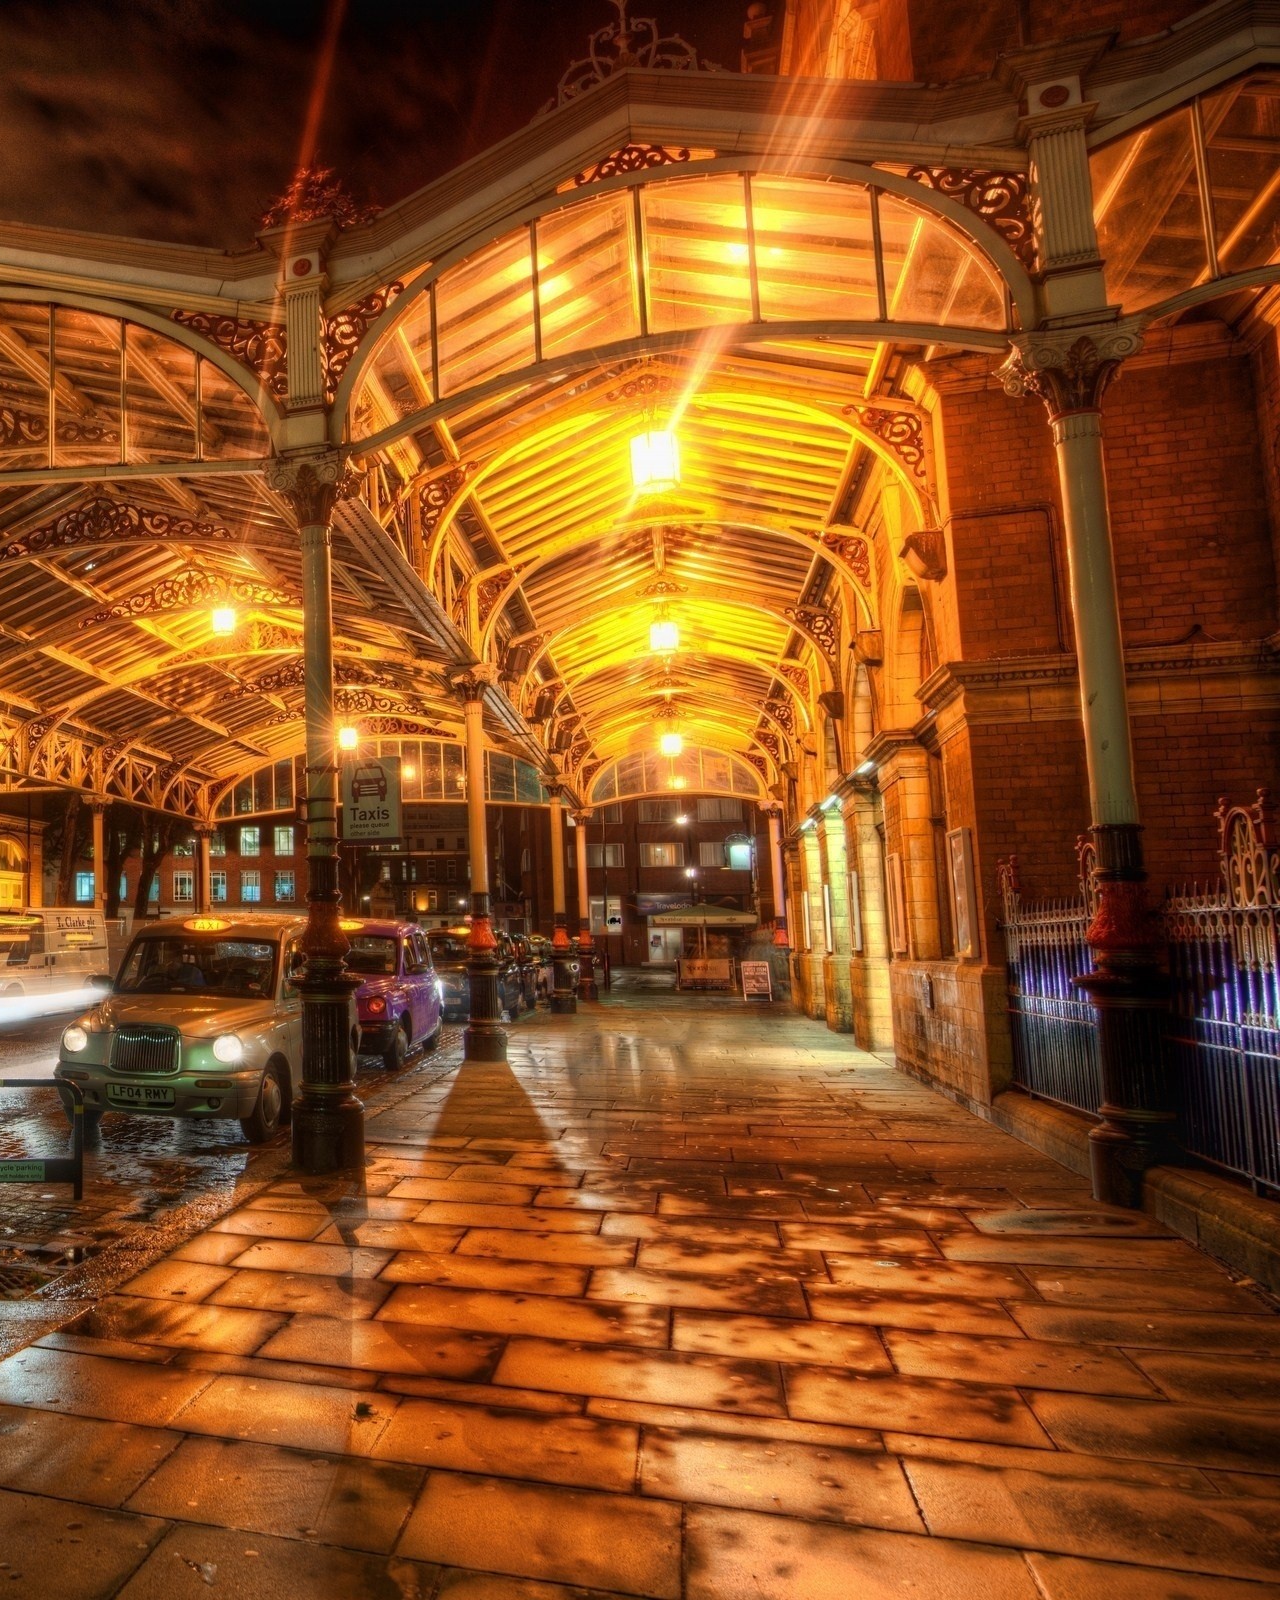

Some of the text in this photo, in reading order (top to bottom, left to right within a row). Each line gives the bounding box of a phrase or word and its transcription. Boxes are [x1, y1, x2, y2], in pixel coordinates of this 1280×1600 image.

[350, 806, 389, 821] Taxis
[65, 916, 85, 928] Clarke
[192, 921, 219, 930] TAXI
[112, 1085, 168, 1100] LF04 RMY
[15, 1164, 43, 1172] parking
